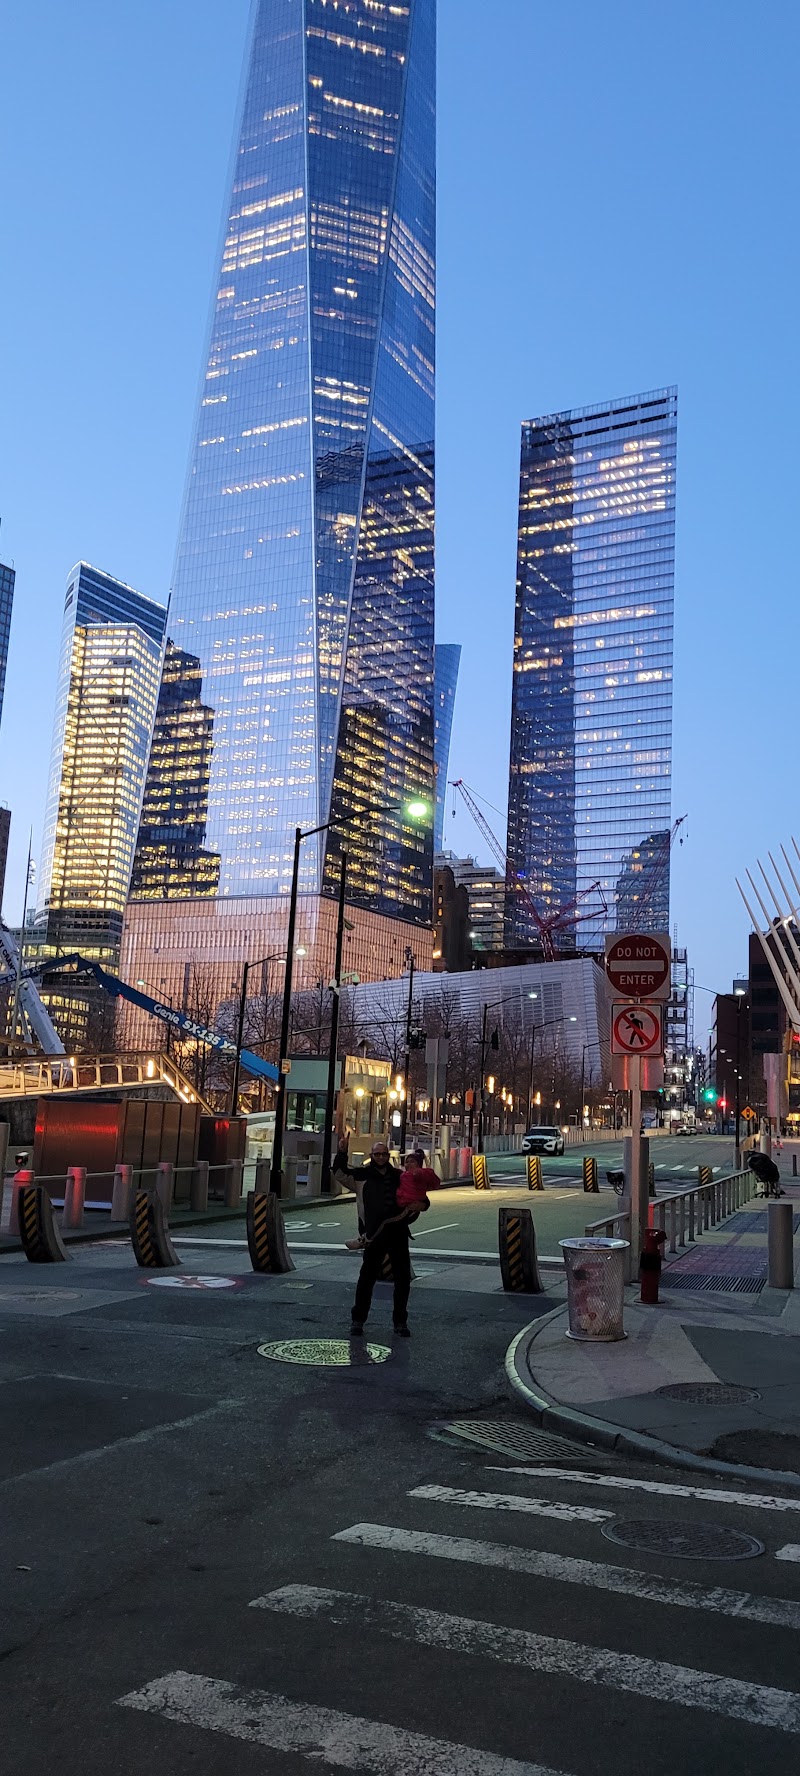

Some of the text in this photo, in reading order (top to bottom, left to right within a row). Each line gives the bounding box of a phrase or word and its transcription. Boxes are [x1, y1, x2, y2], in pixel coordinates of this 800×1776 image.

[617, 947, 657, 957] DO NOT
[620, 975, 654, 984] ENTER
[153, 1004, 180, 1024] Genie
